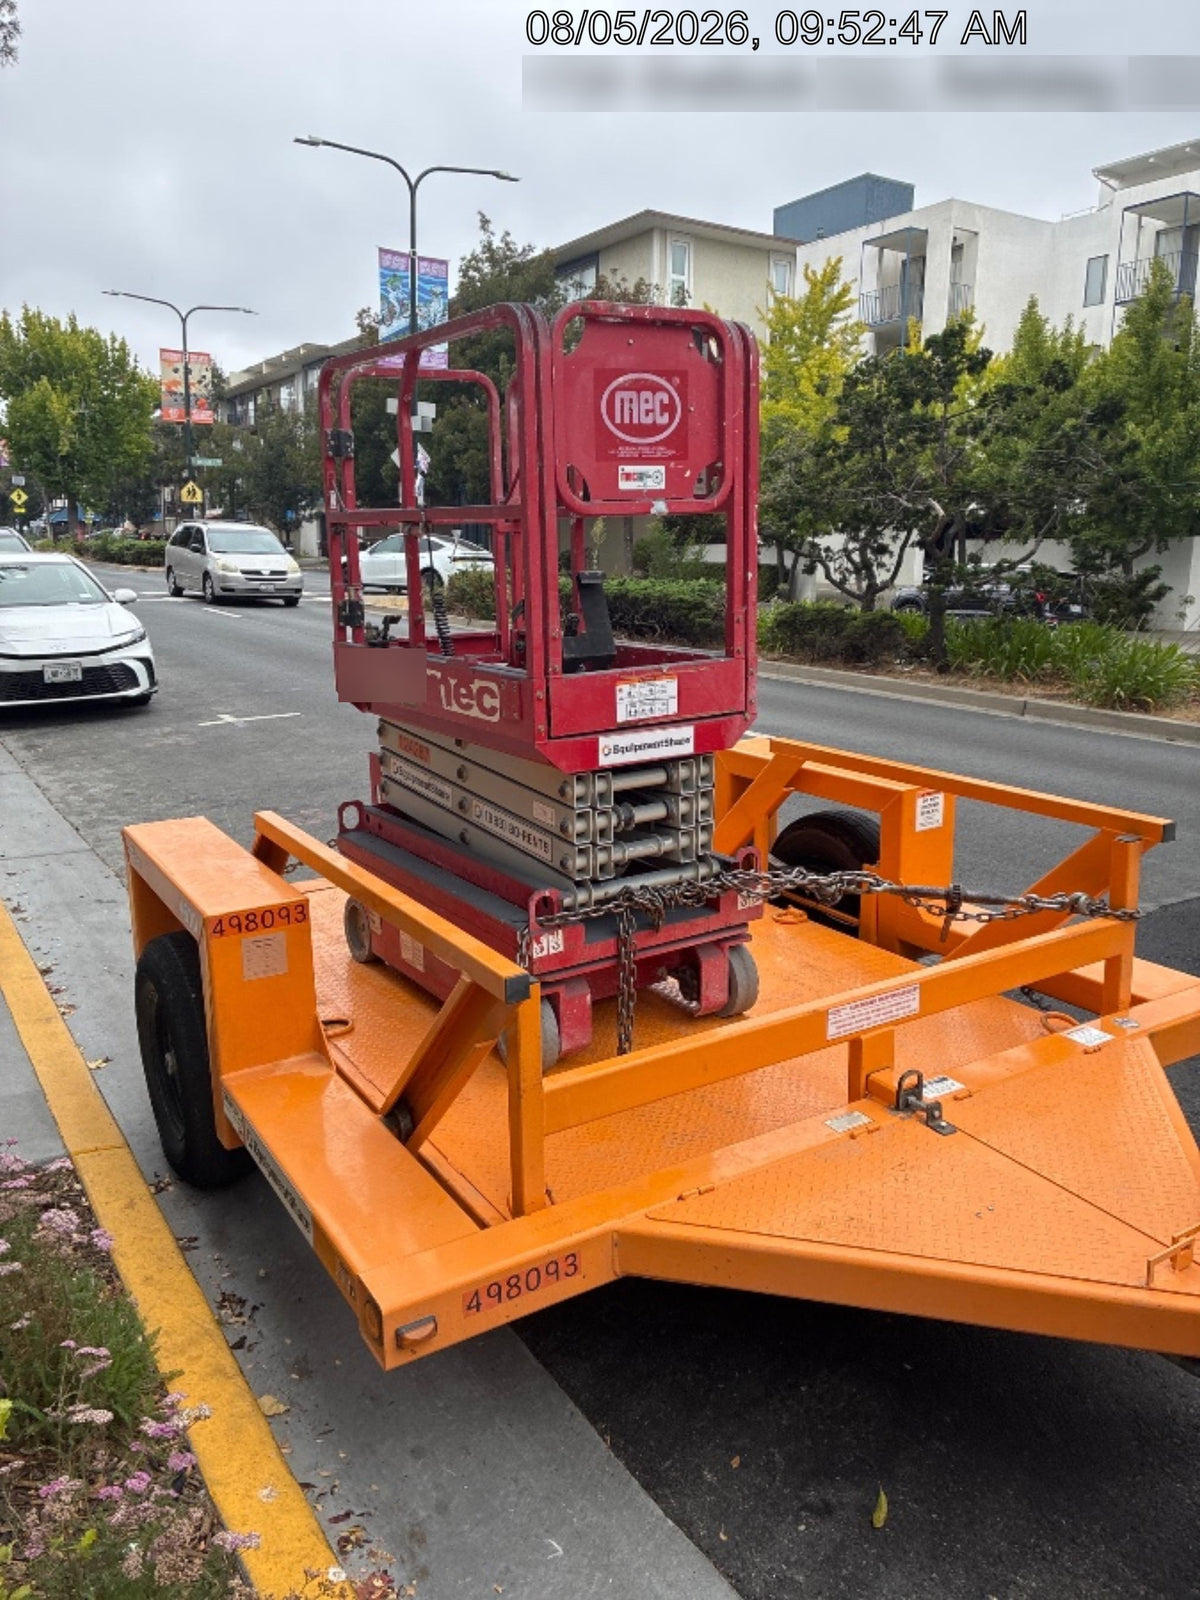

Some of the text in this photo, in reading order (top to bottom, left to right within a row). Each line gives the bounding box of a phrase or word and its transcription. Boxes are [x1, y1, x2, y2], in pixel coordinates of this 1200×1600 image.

[612, 735, 691, 755] EquipmentShare
[212, 904, 307, 937] 498093
[464, 1252, 579, 1314] 498093
